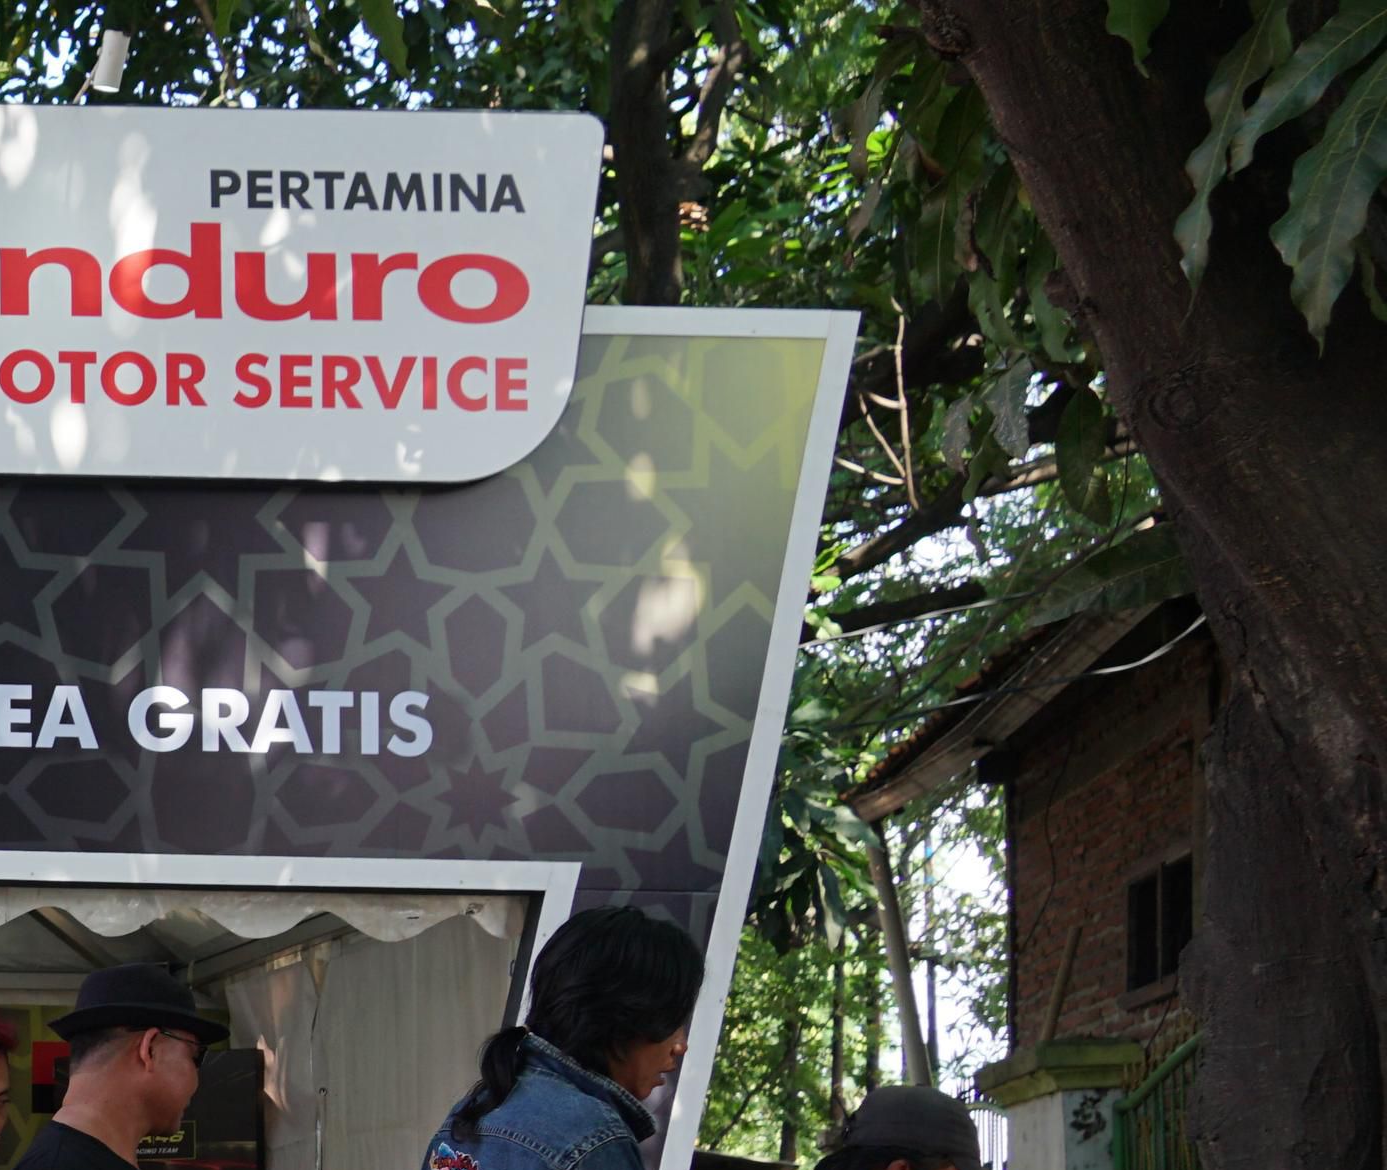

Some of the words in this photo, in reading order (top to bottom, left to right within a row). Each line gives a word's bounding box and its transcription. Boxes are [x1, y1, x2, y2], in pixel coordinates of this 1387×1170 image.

[209, 168, 526, 214] PERTAMINA
[232, 352, 529, 412] SERVICE
[126, 684, 436, 758] GRATIS
